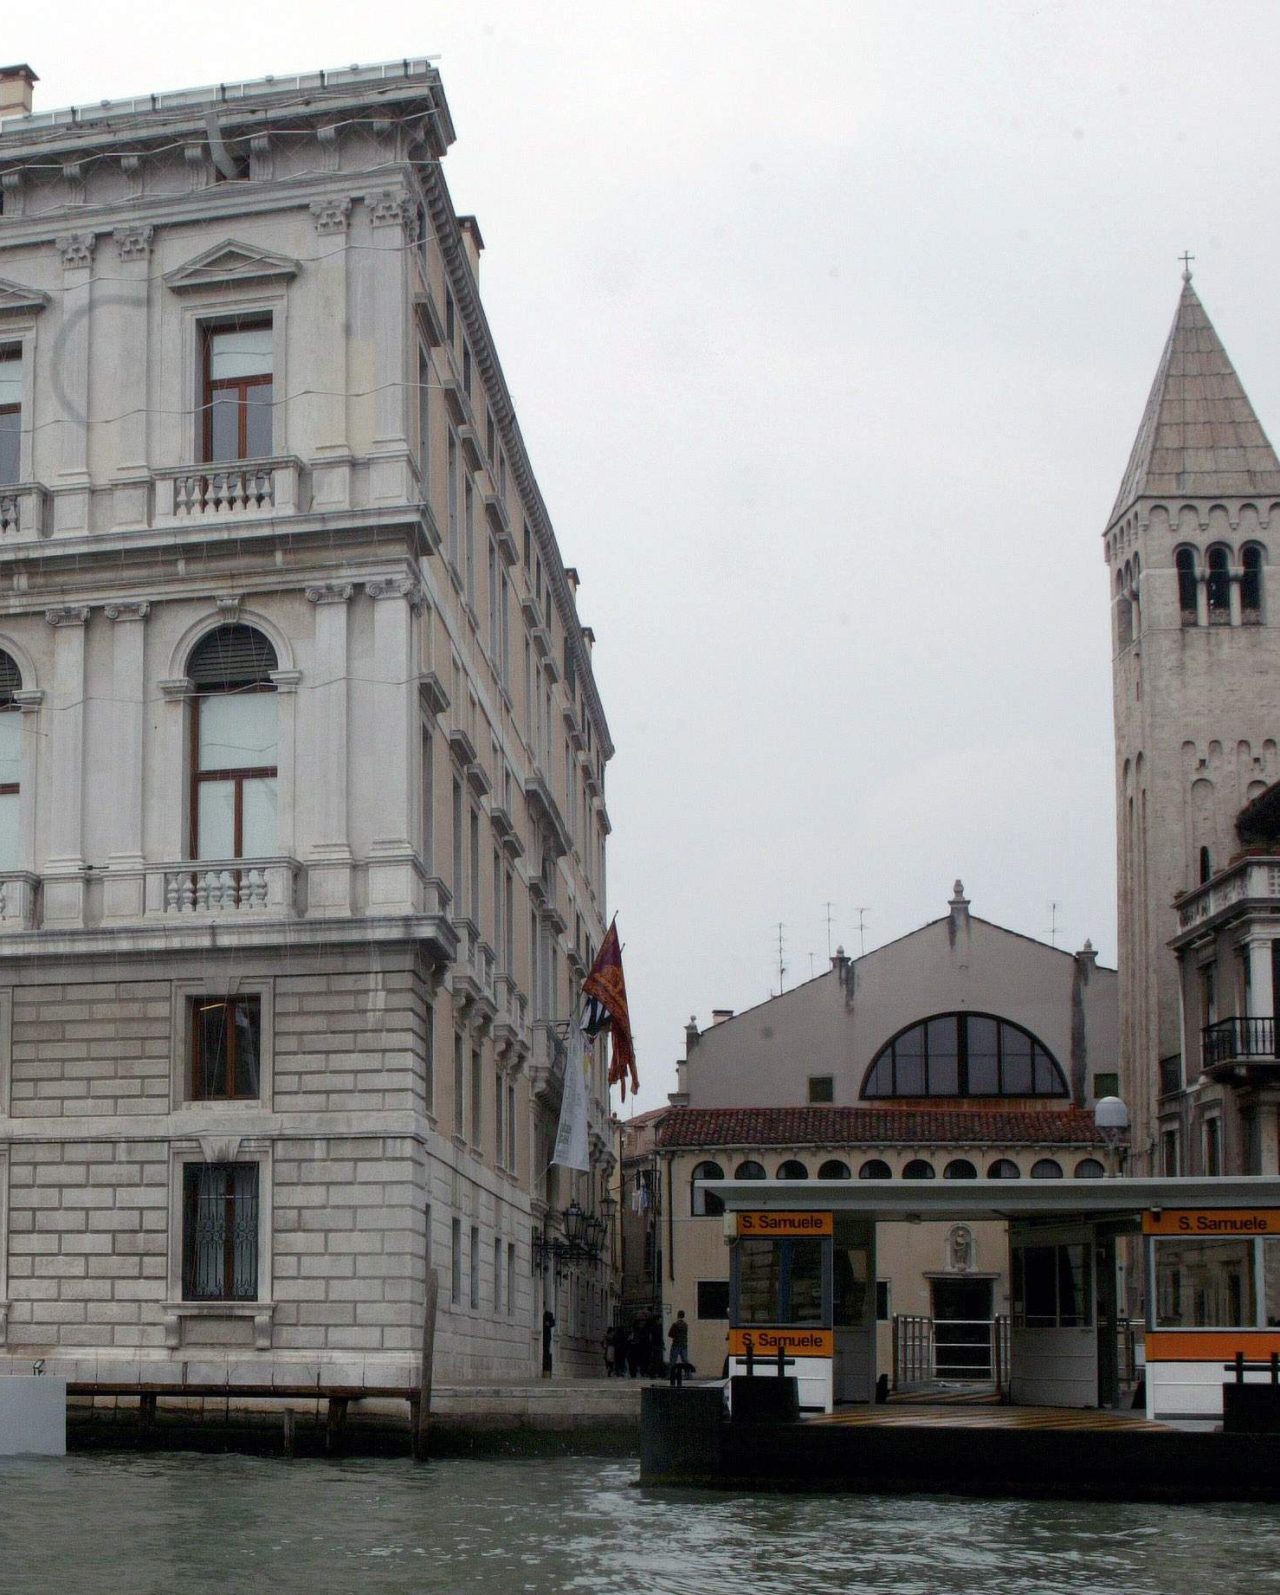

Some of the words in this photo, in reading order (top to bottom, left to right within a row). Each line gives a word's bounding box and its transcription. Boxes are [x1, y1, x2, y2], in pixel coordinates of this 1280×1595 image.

[742, 1216, 756, 1229] S.
[759, 1216, 823, 1229] Samuele
[1179, 1216, 1193, 1230] S.
[1197, 1216, 1267, 1230] Samuele
[759, 1333, 823, 1347] Samuele
